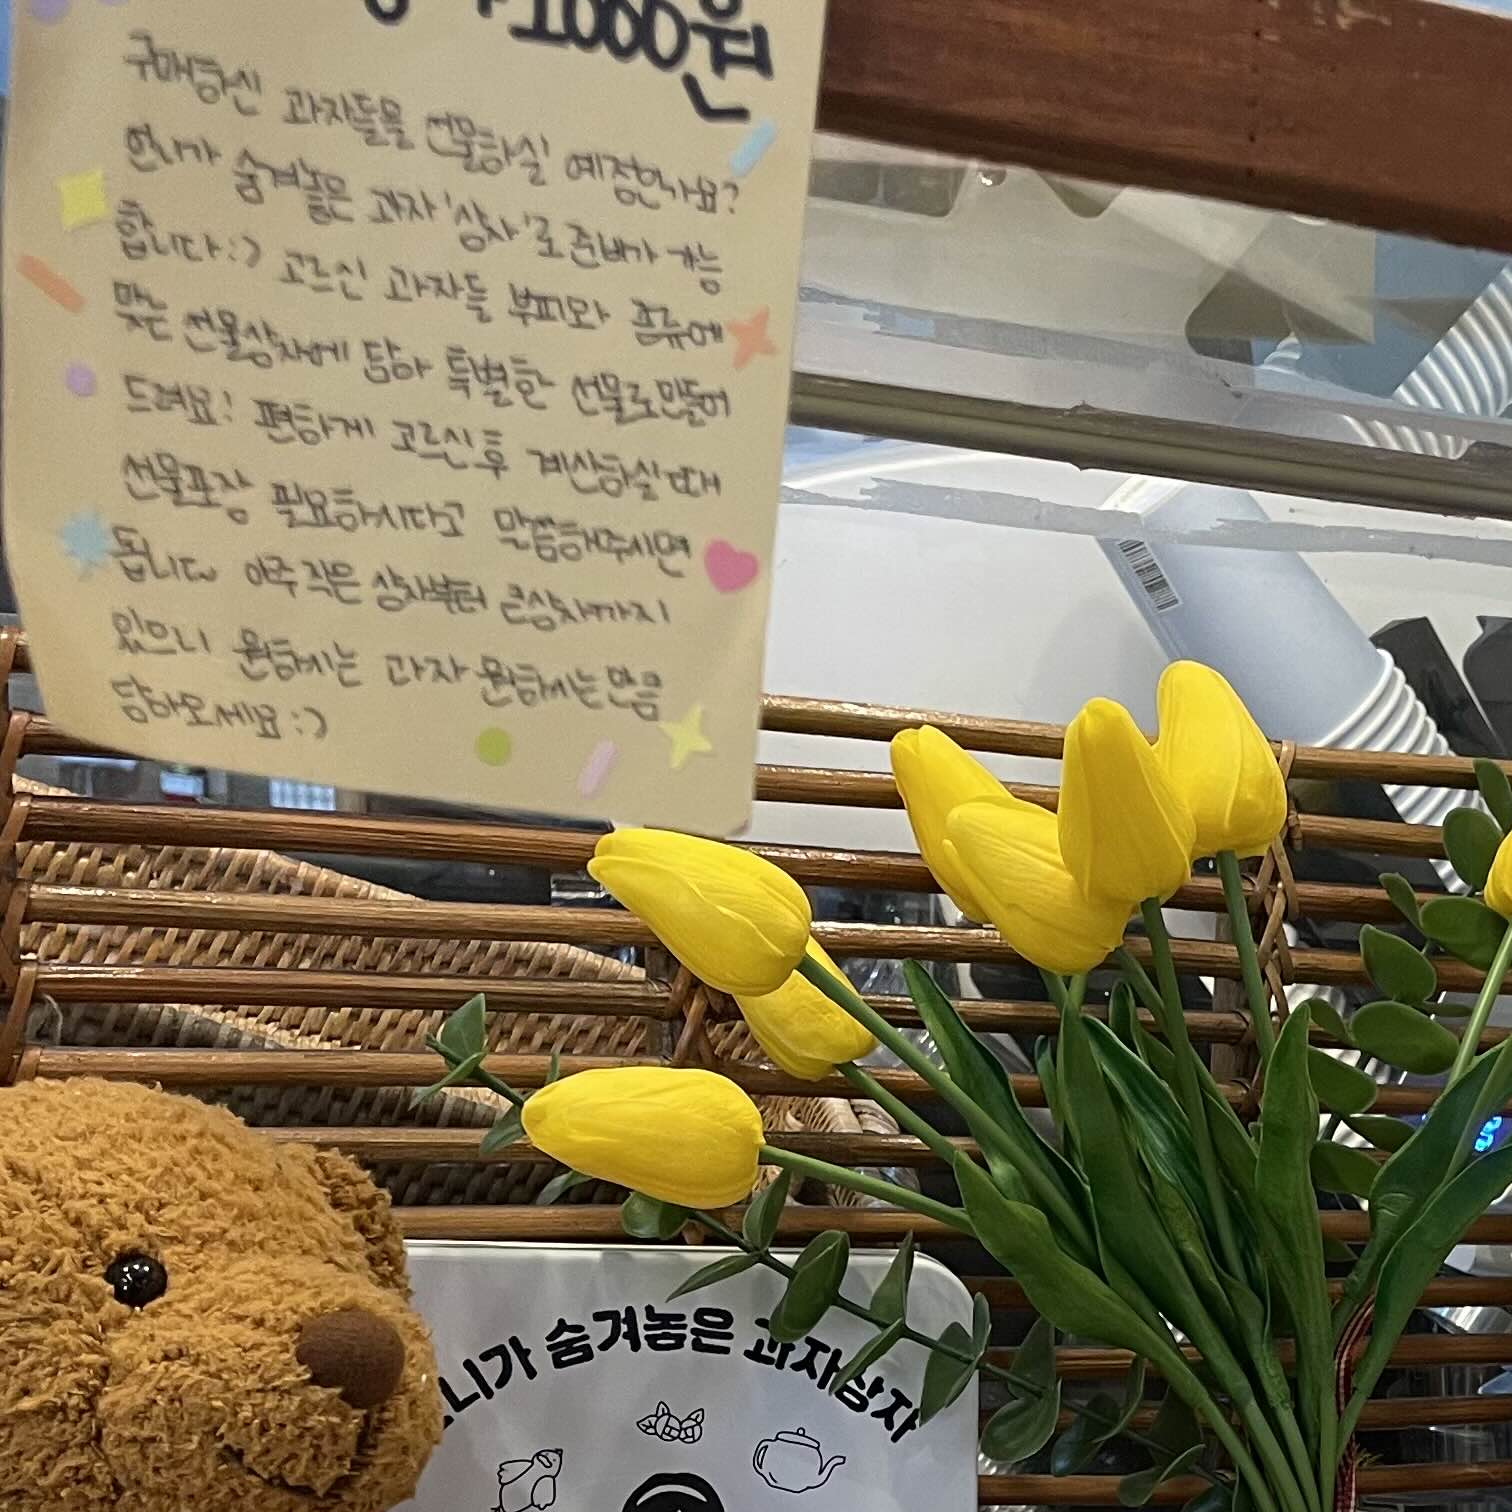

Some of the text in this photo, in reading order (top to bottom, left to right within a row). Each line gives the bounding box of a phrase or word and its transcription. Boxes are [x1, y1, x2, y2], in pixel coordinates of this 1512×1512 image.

[125, 122, 222, 173] 언니가
[282, 88, 415, 150] 과자들을
[280, 250, 367, 301] 고르신
[385, 264, 492, 325] 과자들
[438, 1335, 538, 1431] 니가
[545, 1303, 735, 1371] 숨겨놓은
